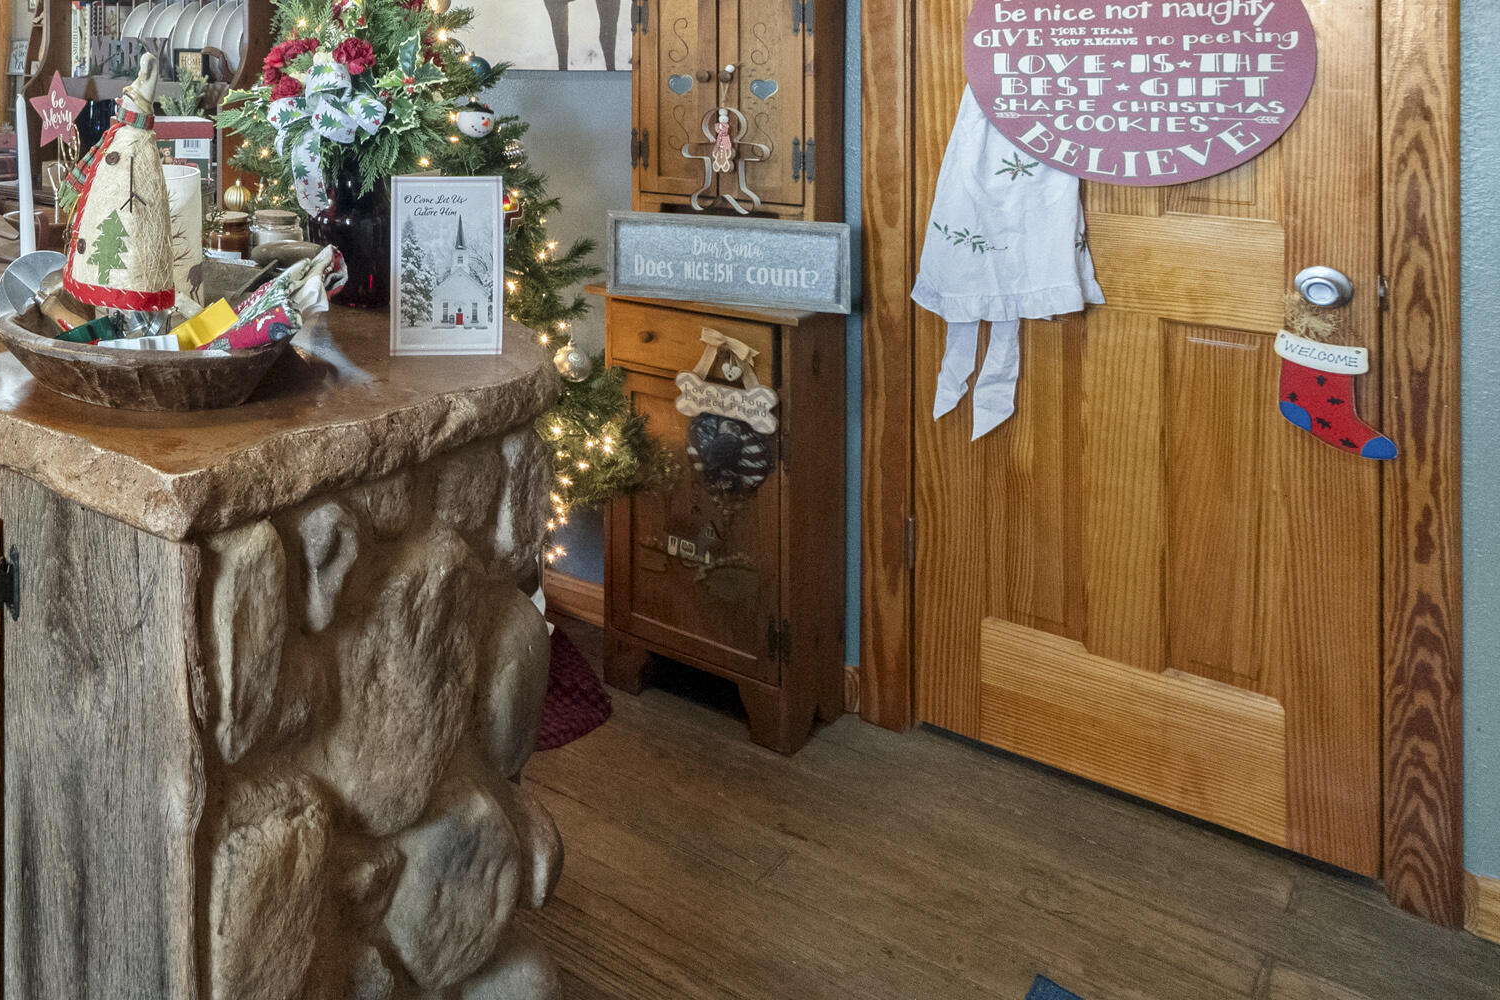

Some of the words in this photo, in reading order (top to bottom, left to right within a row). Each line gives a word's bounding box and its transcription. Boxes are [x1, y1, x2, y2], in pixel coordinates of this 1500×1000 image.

[994, 3, 1026, 23] be
[1033, 4, 1096, 22] nice
[1105, 1, 1153, 20] not
[973, 28, 1043, 48] GIVE
[1050, 27, 1086, 36] MORE
[1091, 27, 1134, 35] THAN
[1051, 37, 1081, 47] YOU
[1083, 37, 1138, 47] RECEIVE
[1145, 34, 1175, 46] no
[1182, 27, 1299, 50] peeking
[90, 36, 168, 80] MERY
[993, 53, 1114, 75] LOVE
[1130, 53, 1175, 74] IS
[1193, 52, 1285, 73] THE
[1001, 76, 1112, 96] BEST
[1139, 76, 1269, 97] GIFT
[51, 90, 66, 108] be
[993, 97, 1097, 111] SHARE
[1112, 100, 1286, 113] CHRISTMAS
[42, 108, 73, 131] Merry
[1053, 114, 1210, 133] COOKIES
[1016, 121, 1262, 177] BELIEVE
[403, 194, 412, 204] O
[413, 194, 434, 204] Come
[435, 194, 450, 204] Let
[451, 194, 467, 204] Us
[413, 206, 438, 216] Adore
[439, 207, 457, 216] Him
[692, 236, 720, 257] Dear
[634, 254, 674, 279] Does
[746, 266, 820, 289] count?
[1284, 340, 1359, 368] WELCOME
[684, 384, 711, 396] Love
[741, 395, 768, 408] Four
[685, 393, 725, 408] Legged
[730, 402, 767, 418] Friend
